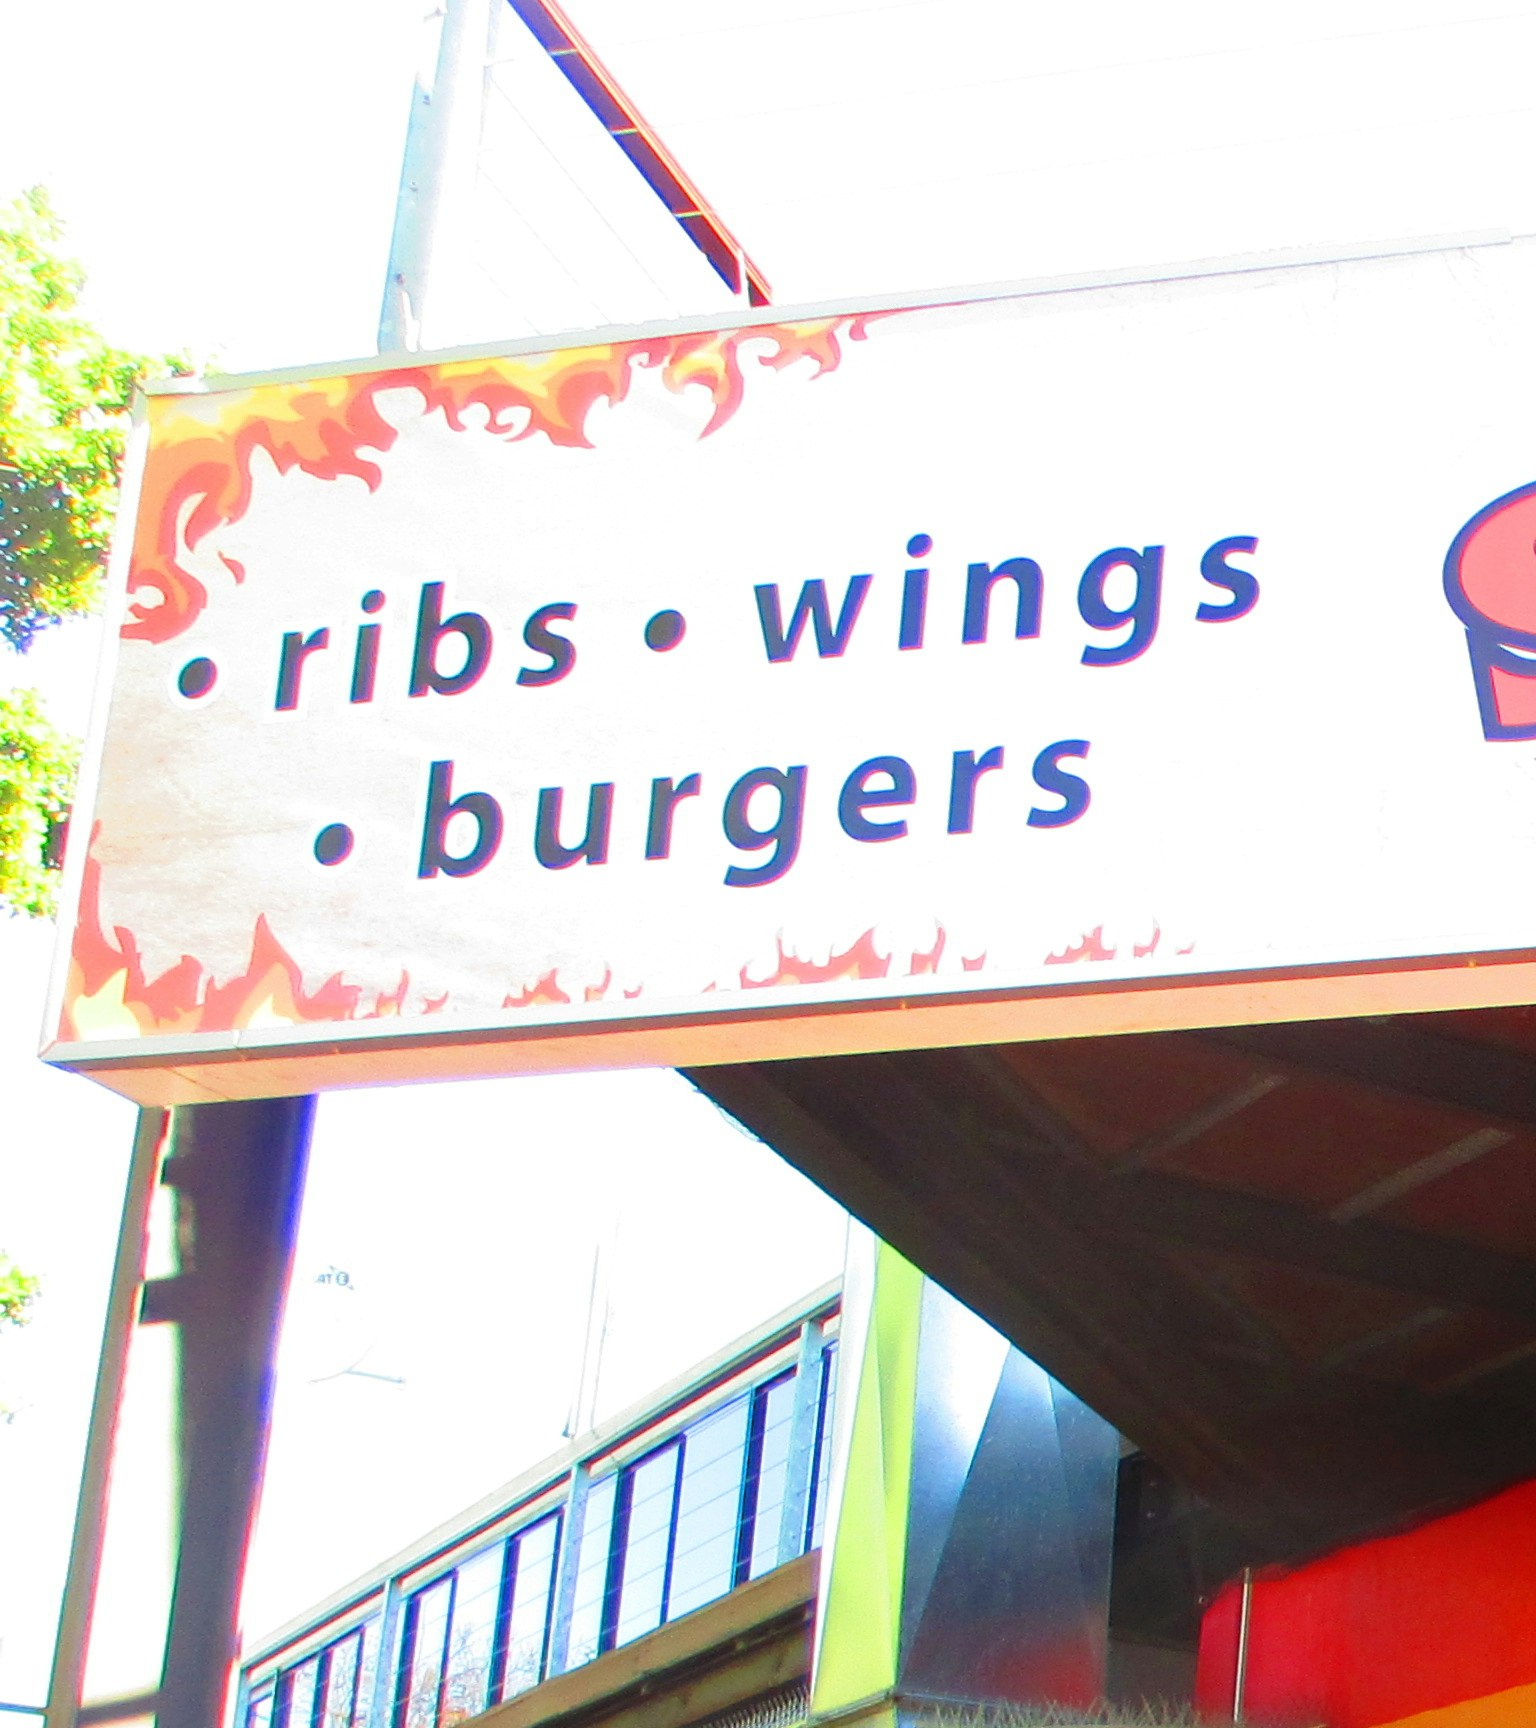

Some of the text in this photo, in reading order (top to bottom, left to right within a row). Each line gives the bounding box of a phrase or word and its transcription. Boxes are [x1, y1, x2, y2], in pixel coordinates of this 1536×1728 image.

[274, 533, 1260, 711] ribs wings
[417, 739, 1091, 887] burgers
